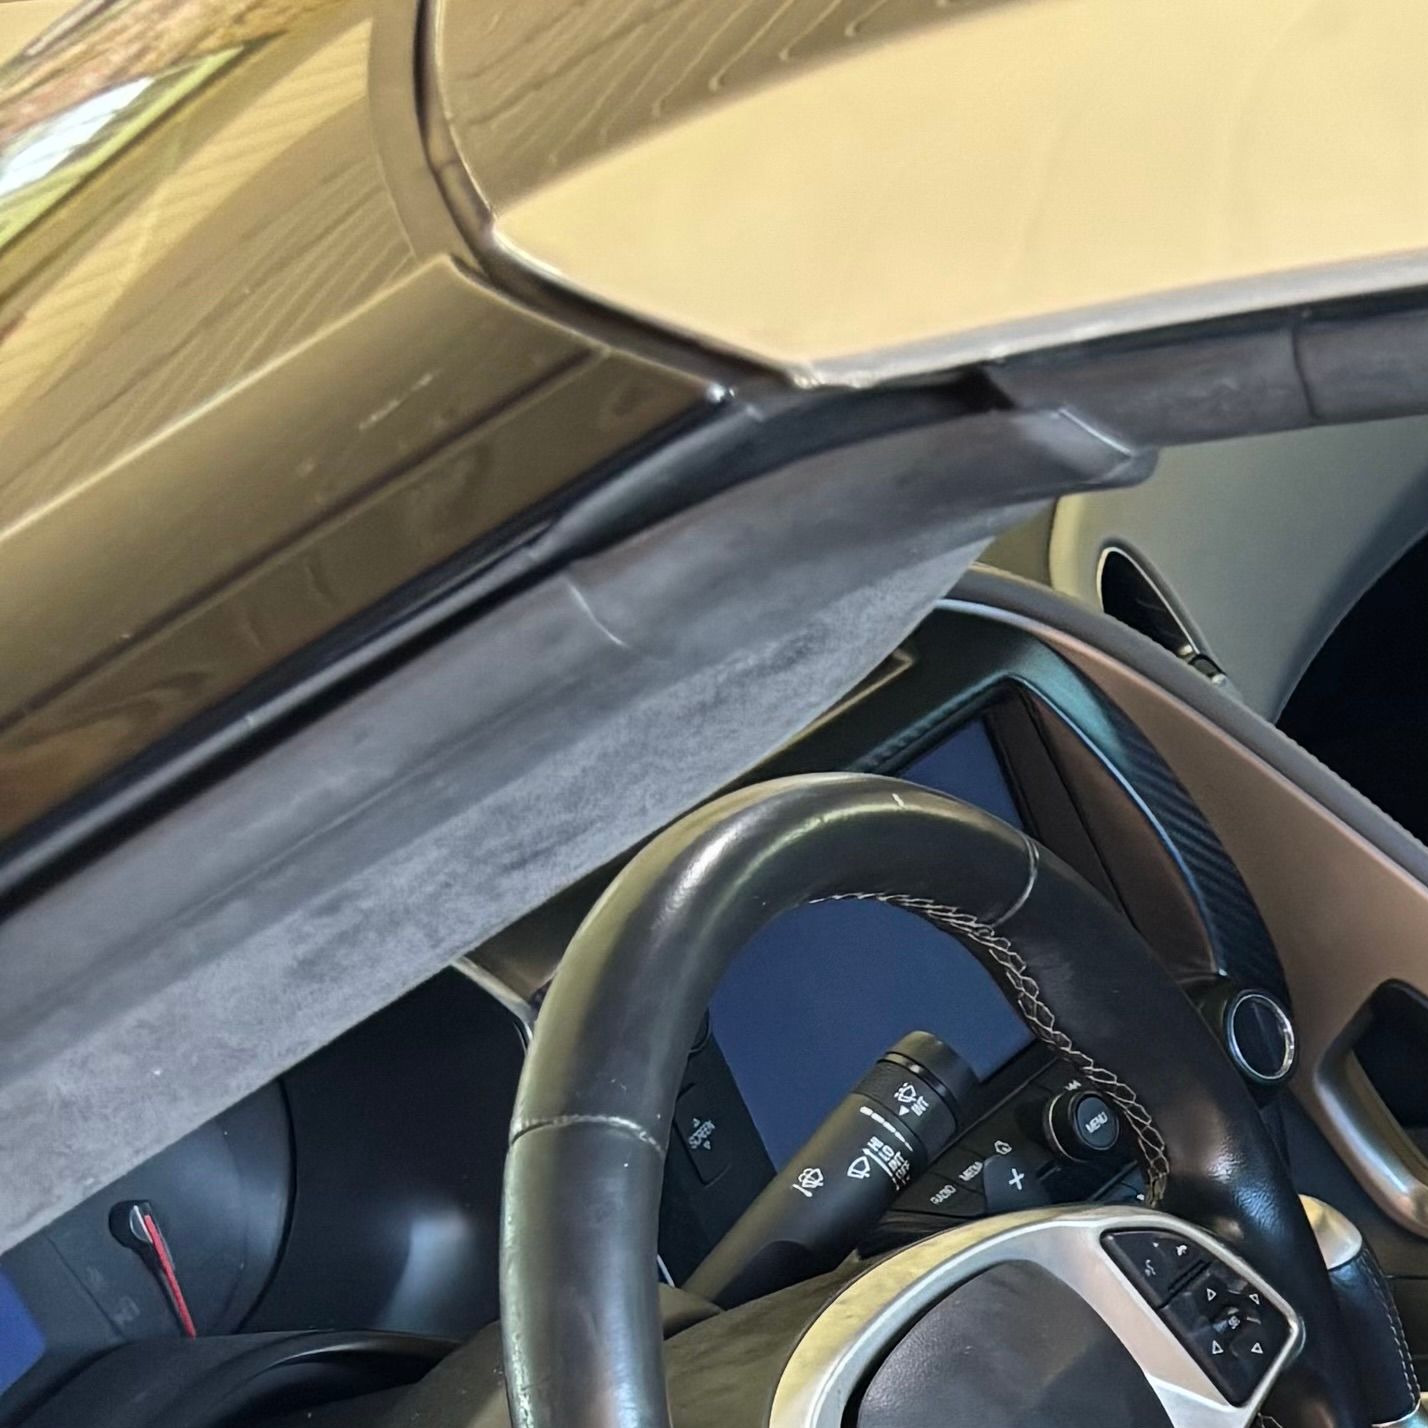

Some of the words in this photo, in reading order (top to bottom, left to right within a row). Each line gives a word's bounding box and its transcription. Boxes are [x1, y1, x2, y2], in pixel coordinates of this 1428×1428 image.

[911, 1095, 929, 1116] INT
[1085, 1111, 1108, 1133] MENU
[689, 1120, 715, 1148] SCREEN
[867, 1136, 884, 1152] HI
[878, 1145, 895, 1162] LO
[888, 1151, 906, 1171] INT
[959, 1161, 984, 1182] MEDIA
